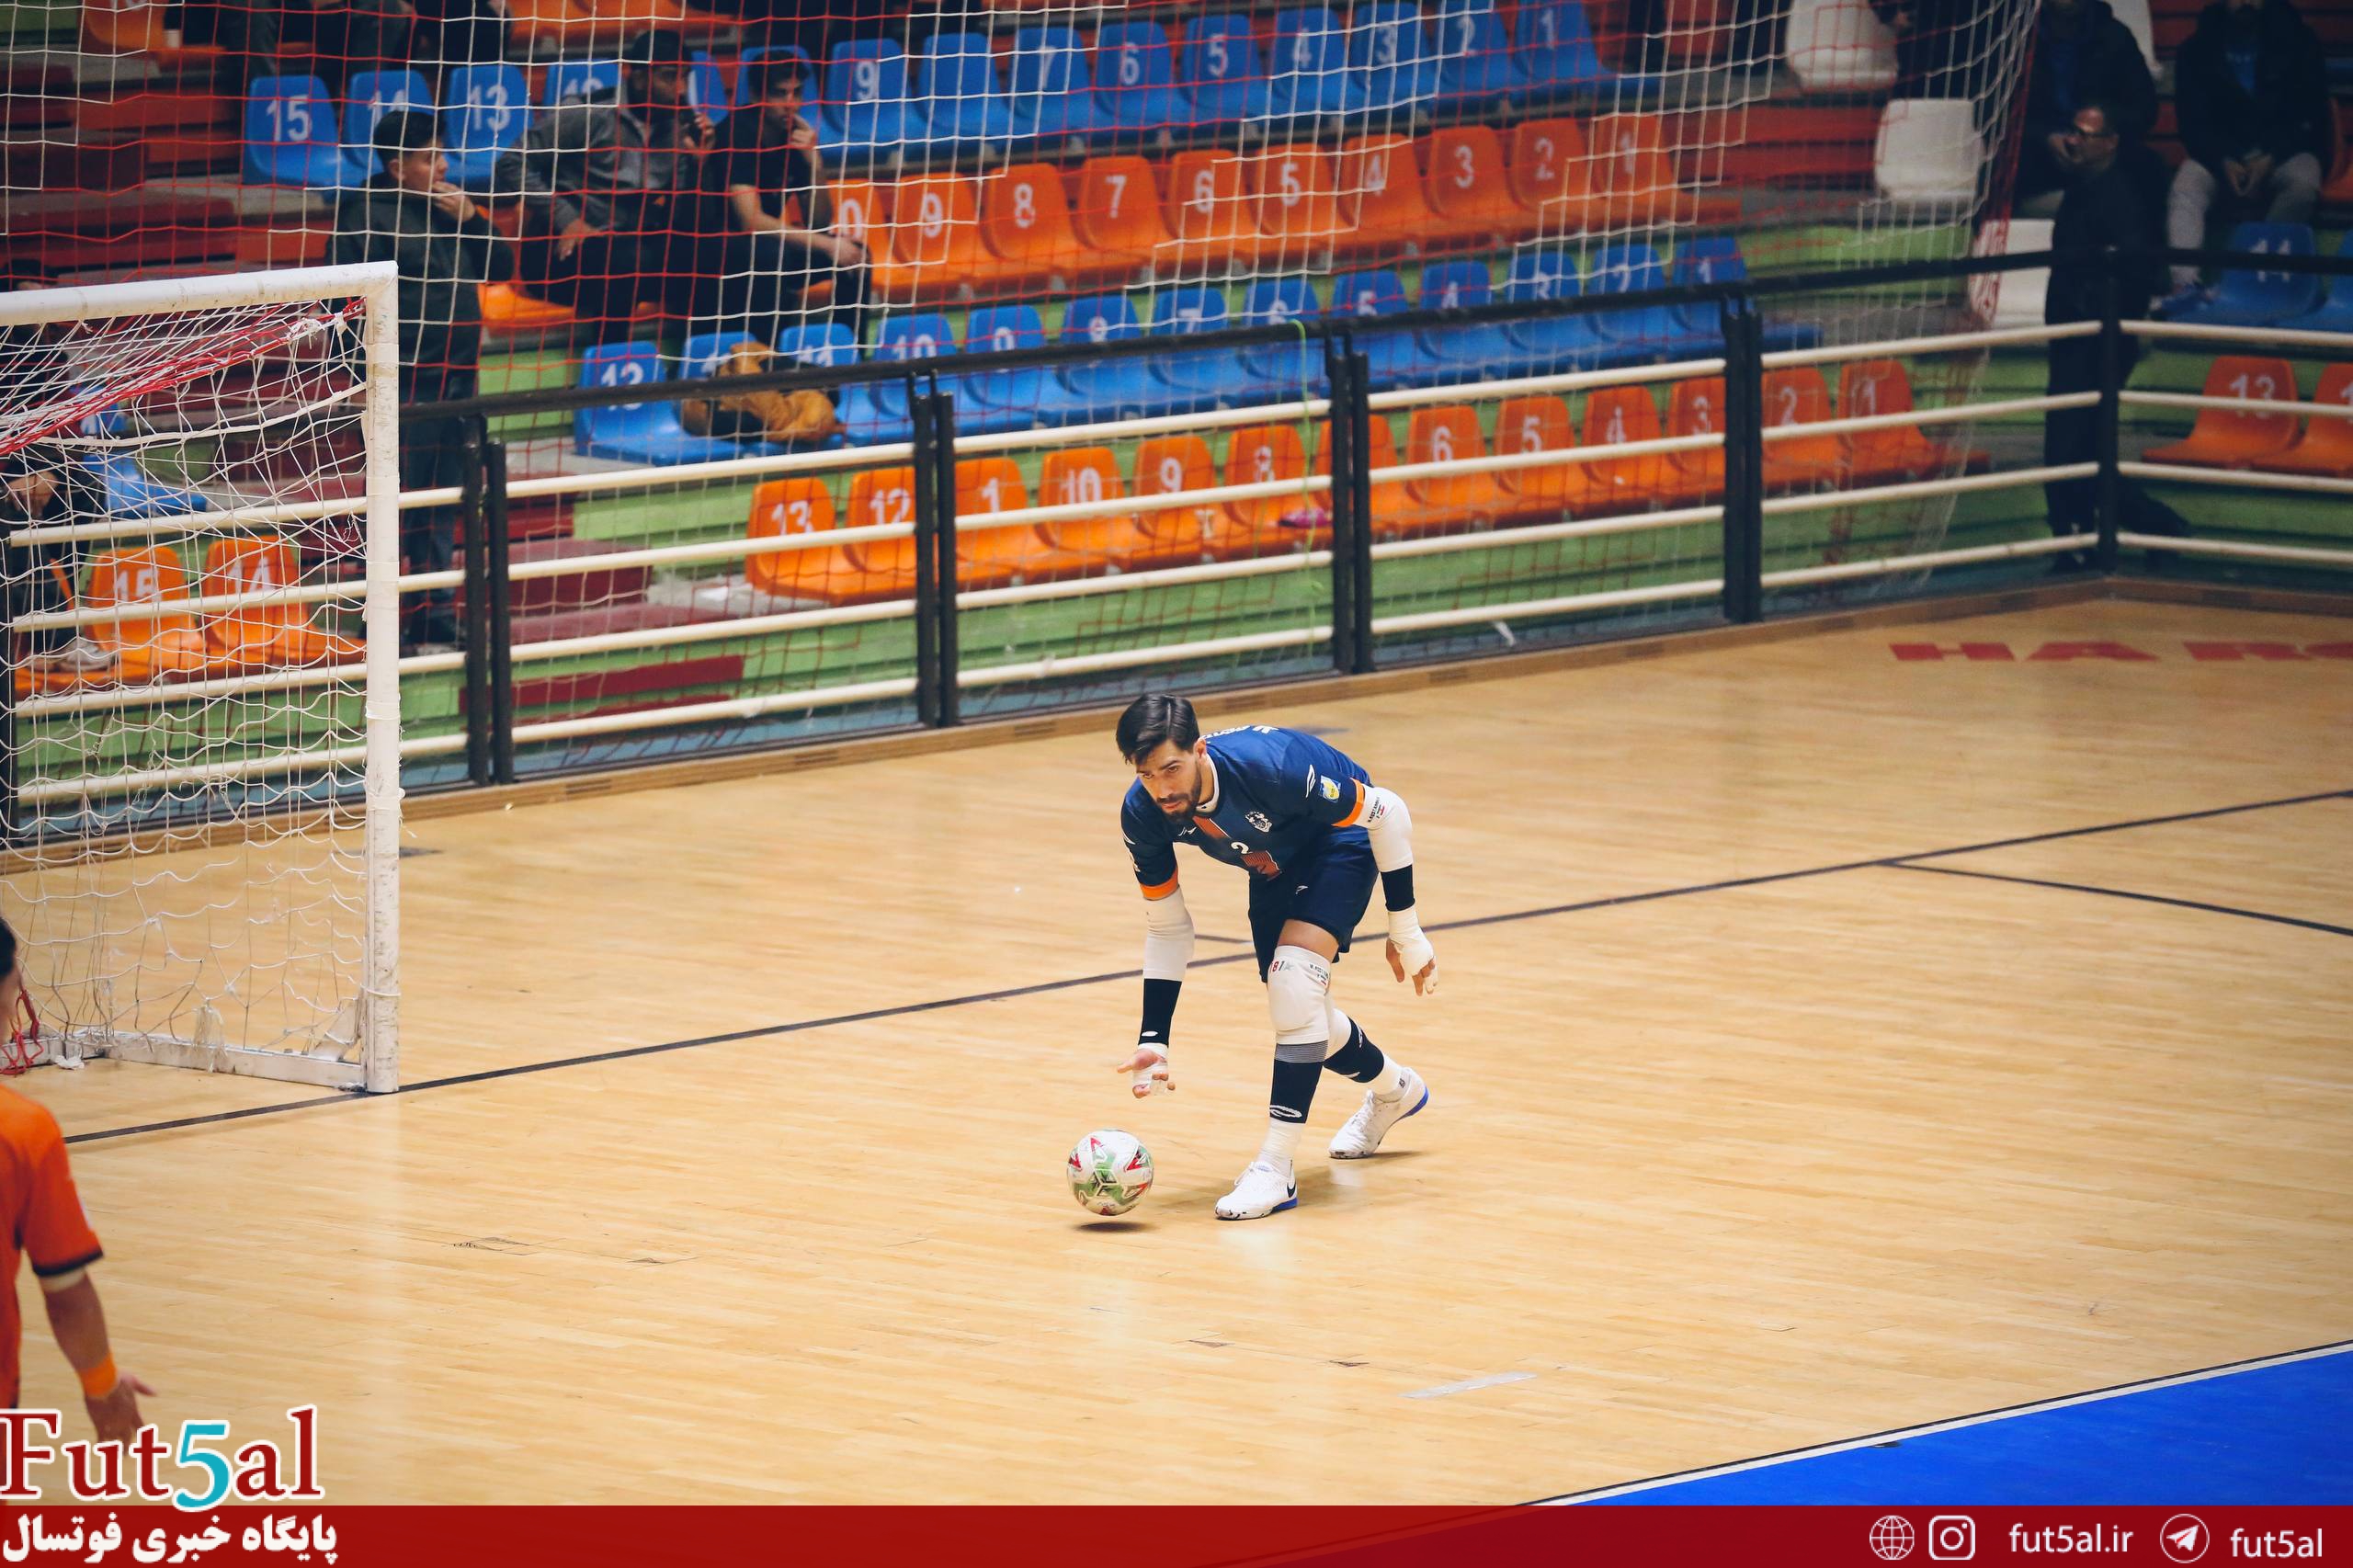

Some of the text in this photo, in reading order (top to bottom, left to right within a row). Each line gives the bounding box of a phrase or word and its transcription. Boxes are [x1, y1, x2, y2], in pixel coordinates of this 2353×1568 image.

[1120, 44, 1141, 85] 6
[1207, 33, 1229, 76] 5
[856, 60, 880, 100] 9
[266, 95, 313, 142] 15
[467, 85, 510, 131] 13
[1454, 145, 1475, 188] 3
[1535, 138, 1555, 181] 2
[1106, 175, 1127, 218] 7
[1194, 170, 1215, 213] 6
[1279, 162, 1302, 206] 5
[922, 191, 943, 238] 9
[1014, 184, 1036, 228] 8
[1779, 386, 1798, 426] 2
[1432, 426, 1453, 461] 6
[1160, 457, 1182, 494] 9
